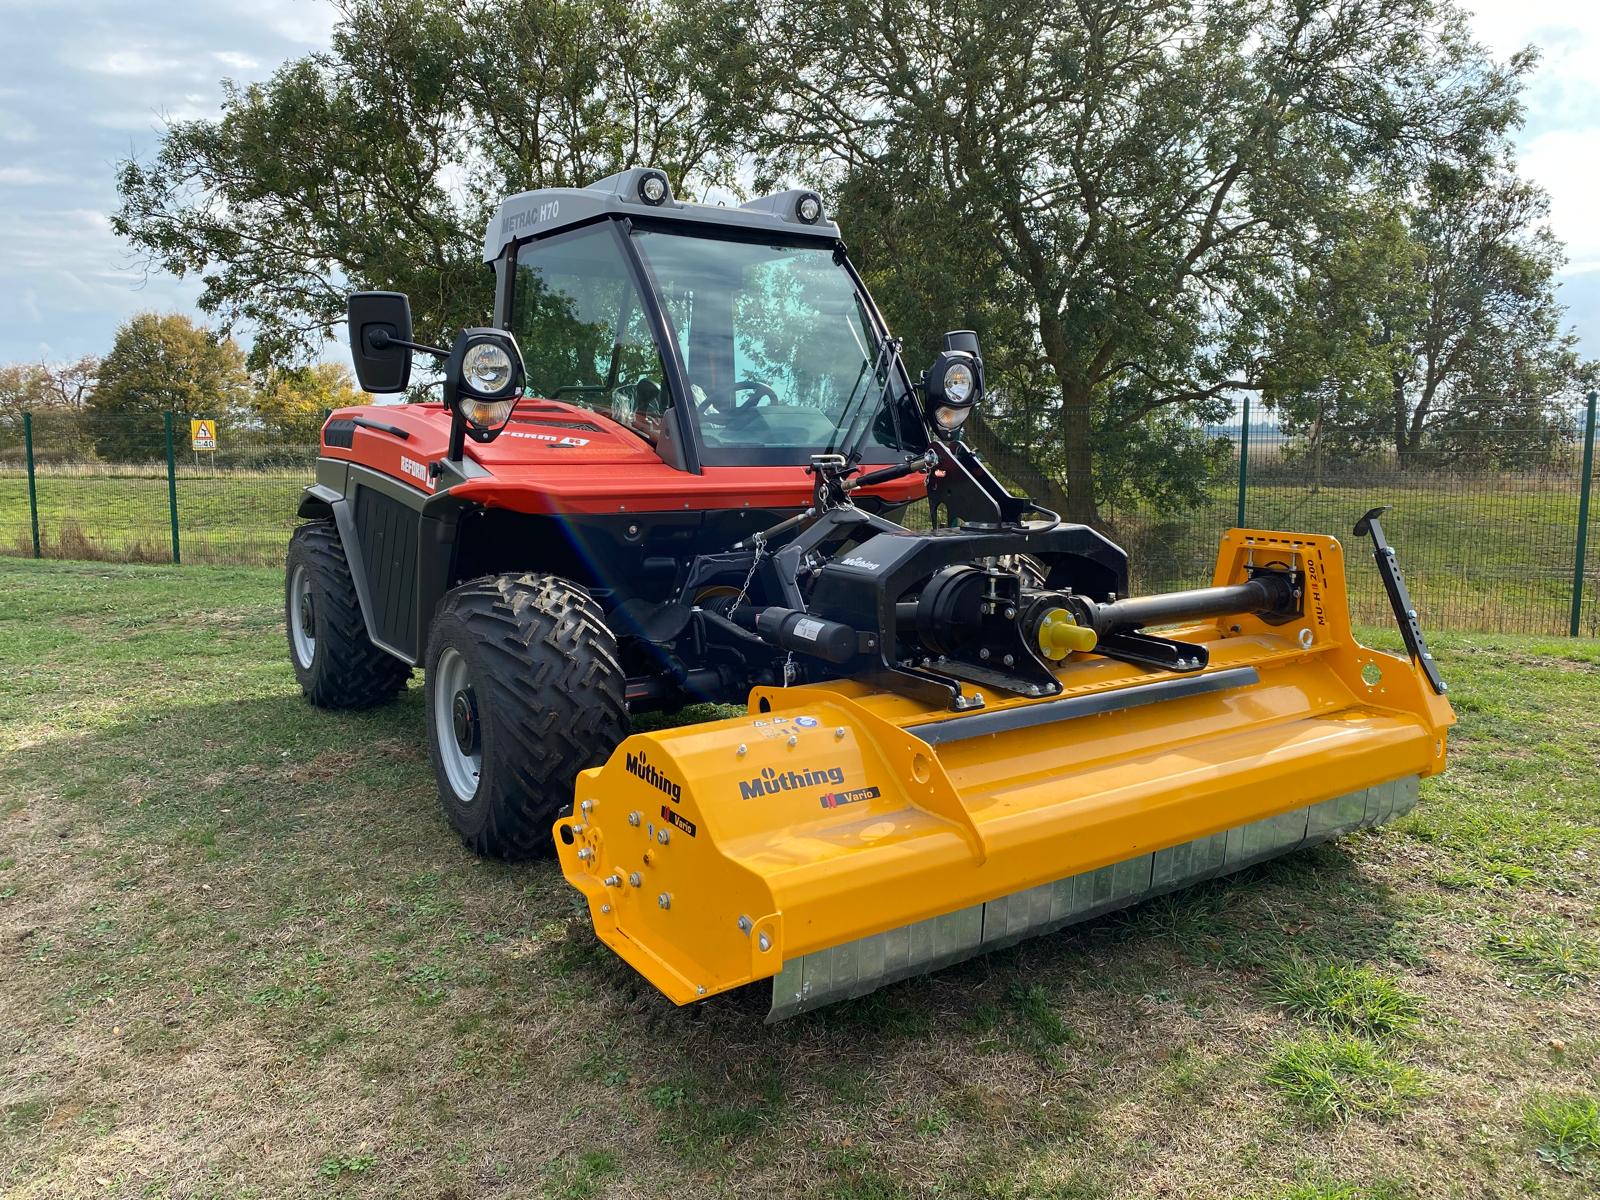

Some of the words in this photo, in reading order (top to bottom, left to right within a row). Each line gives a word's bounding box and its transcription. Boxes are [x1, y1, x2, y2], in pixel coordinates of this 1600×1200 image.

[502, 207, 538, 234] METRAC
[540, 200, 559, 222] H70
[400, 455, 427, 482] REFORM
[1307, 559, 1317, 581] 200
[1313, 592, 1325, 626] MU-H
[625, 751, 681, 804] Müthing
[738, 767, 845, 801] Müthing
[844, 789, 873, 802] Vario
[674, 814, 692, 835] Vario
